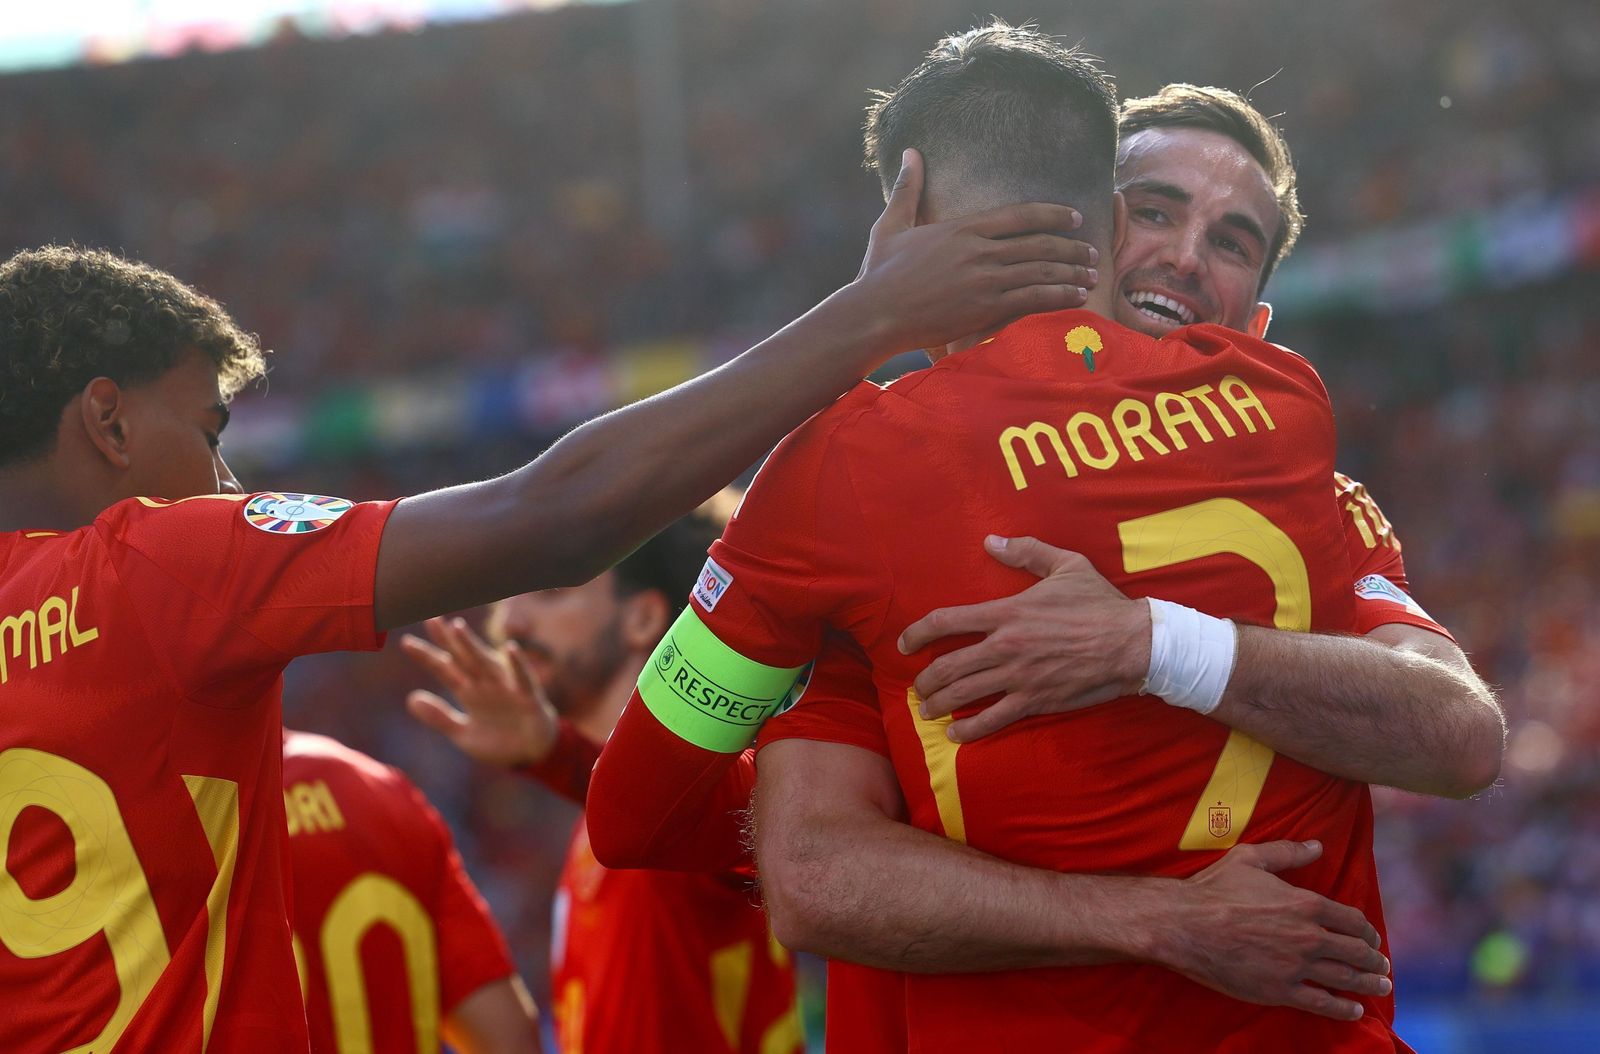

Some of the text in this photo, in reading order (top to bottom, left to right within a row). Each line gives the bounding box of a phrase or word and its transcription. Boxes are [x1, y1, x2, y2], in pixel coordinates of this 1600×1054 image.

[999, 374, 1276, 491] MORATA
[673, 666, 771, 721] RESPECT
[1117, 497, 1312, 850] 7
